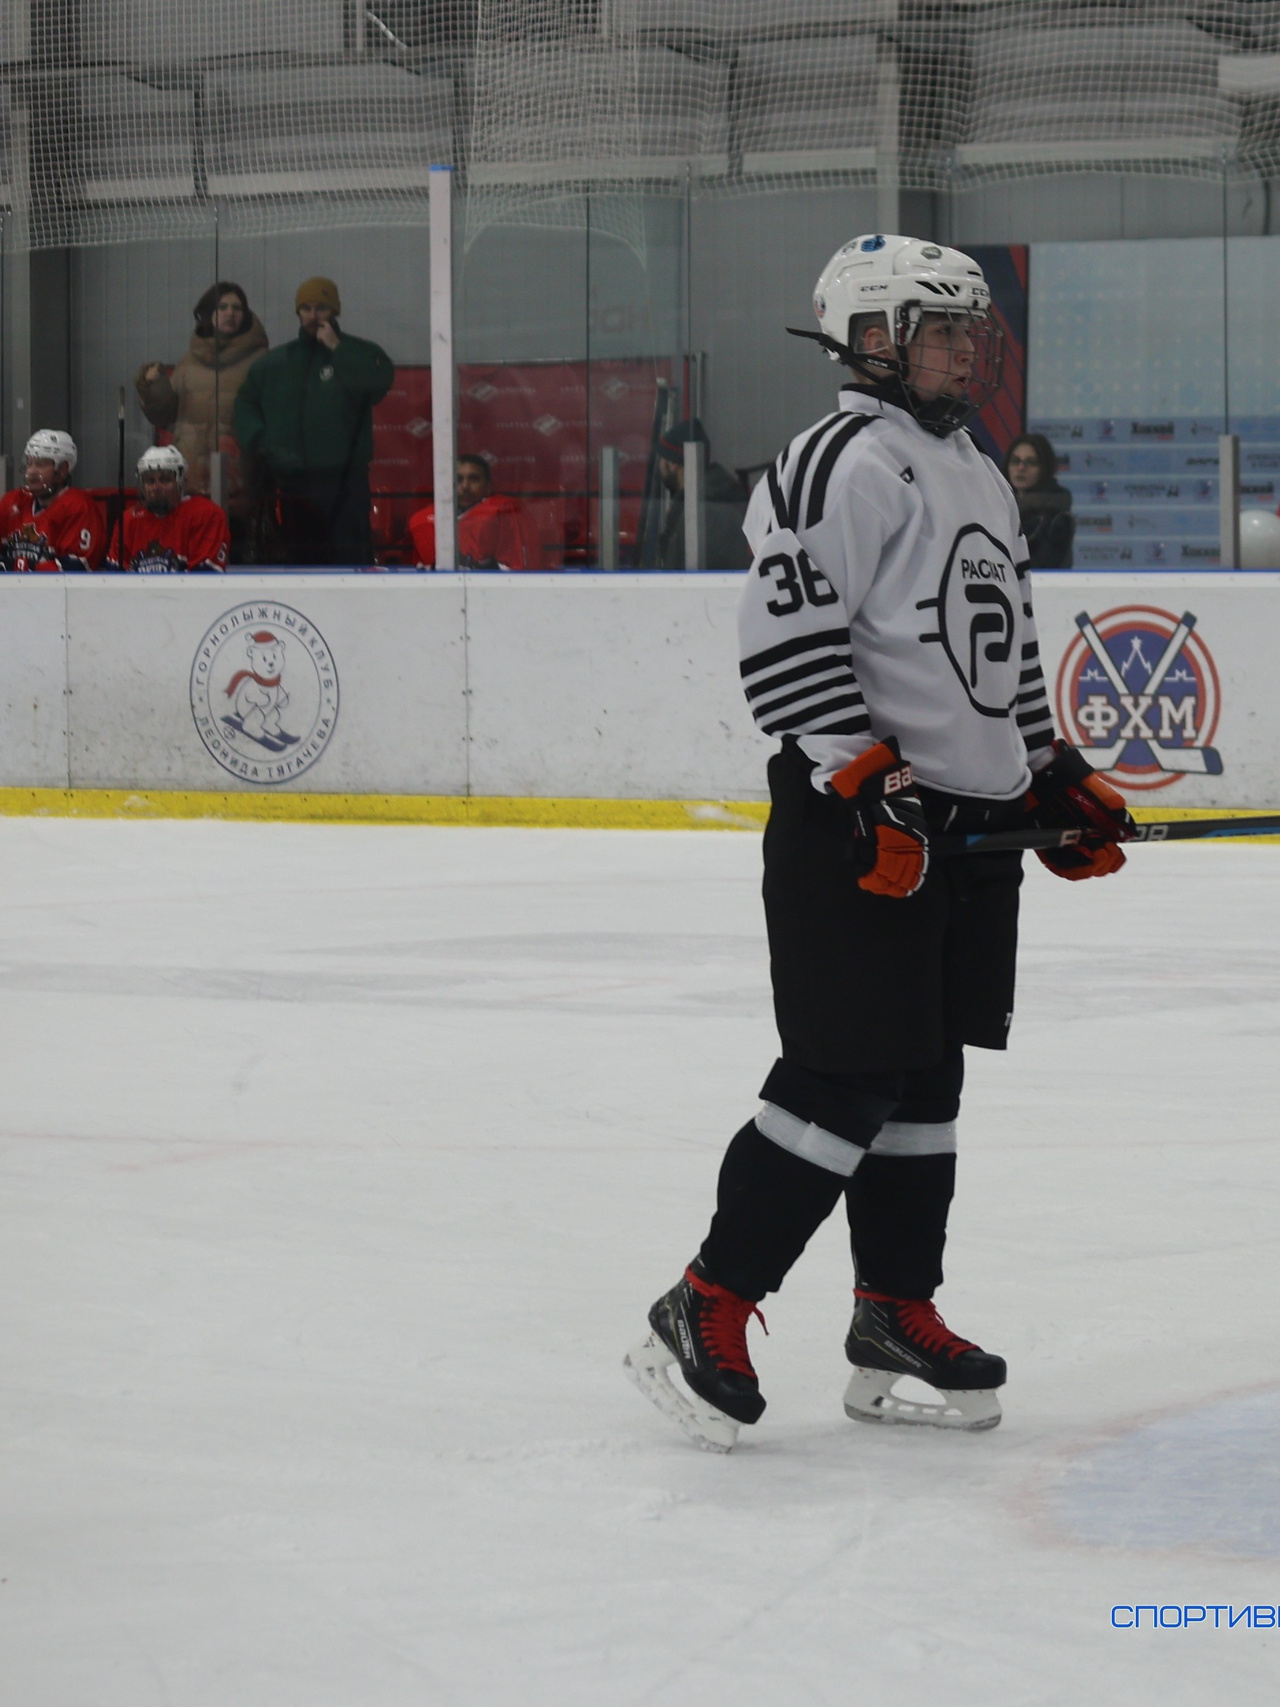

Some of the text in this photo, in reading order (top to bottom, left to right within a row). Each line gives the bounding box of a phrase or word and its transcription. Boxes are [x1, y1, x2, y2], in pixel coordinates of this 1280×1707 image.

[860, 284, 889, 292] CCM
[867, 358, 889, 368] CCM
[80, 528, 92, 550] 9
[758, 549, 840, 618] 36
[196, 607, 333, 690] ГОРНОЛЫЖНЫЙ КЛУБ
[1077, 694, 1197, 740] ФХМ
[198, 716, 331, 779] ЛЕОНИДА ТЯГАЧЕВА
